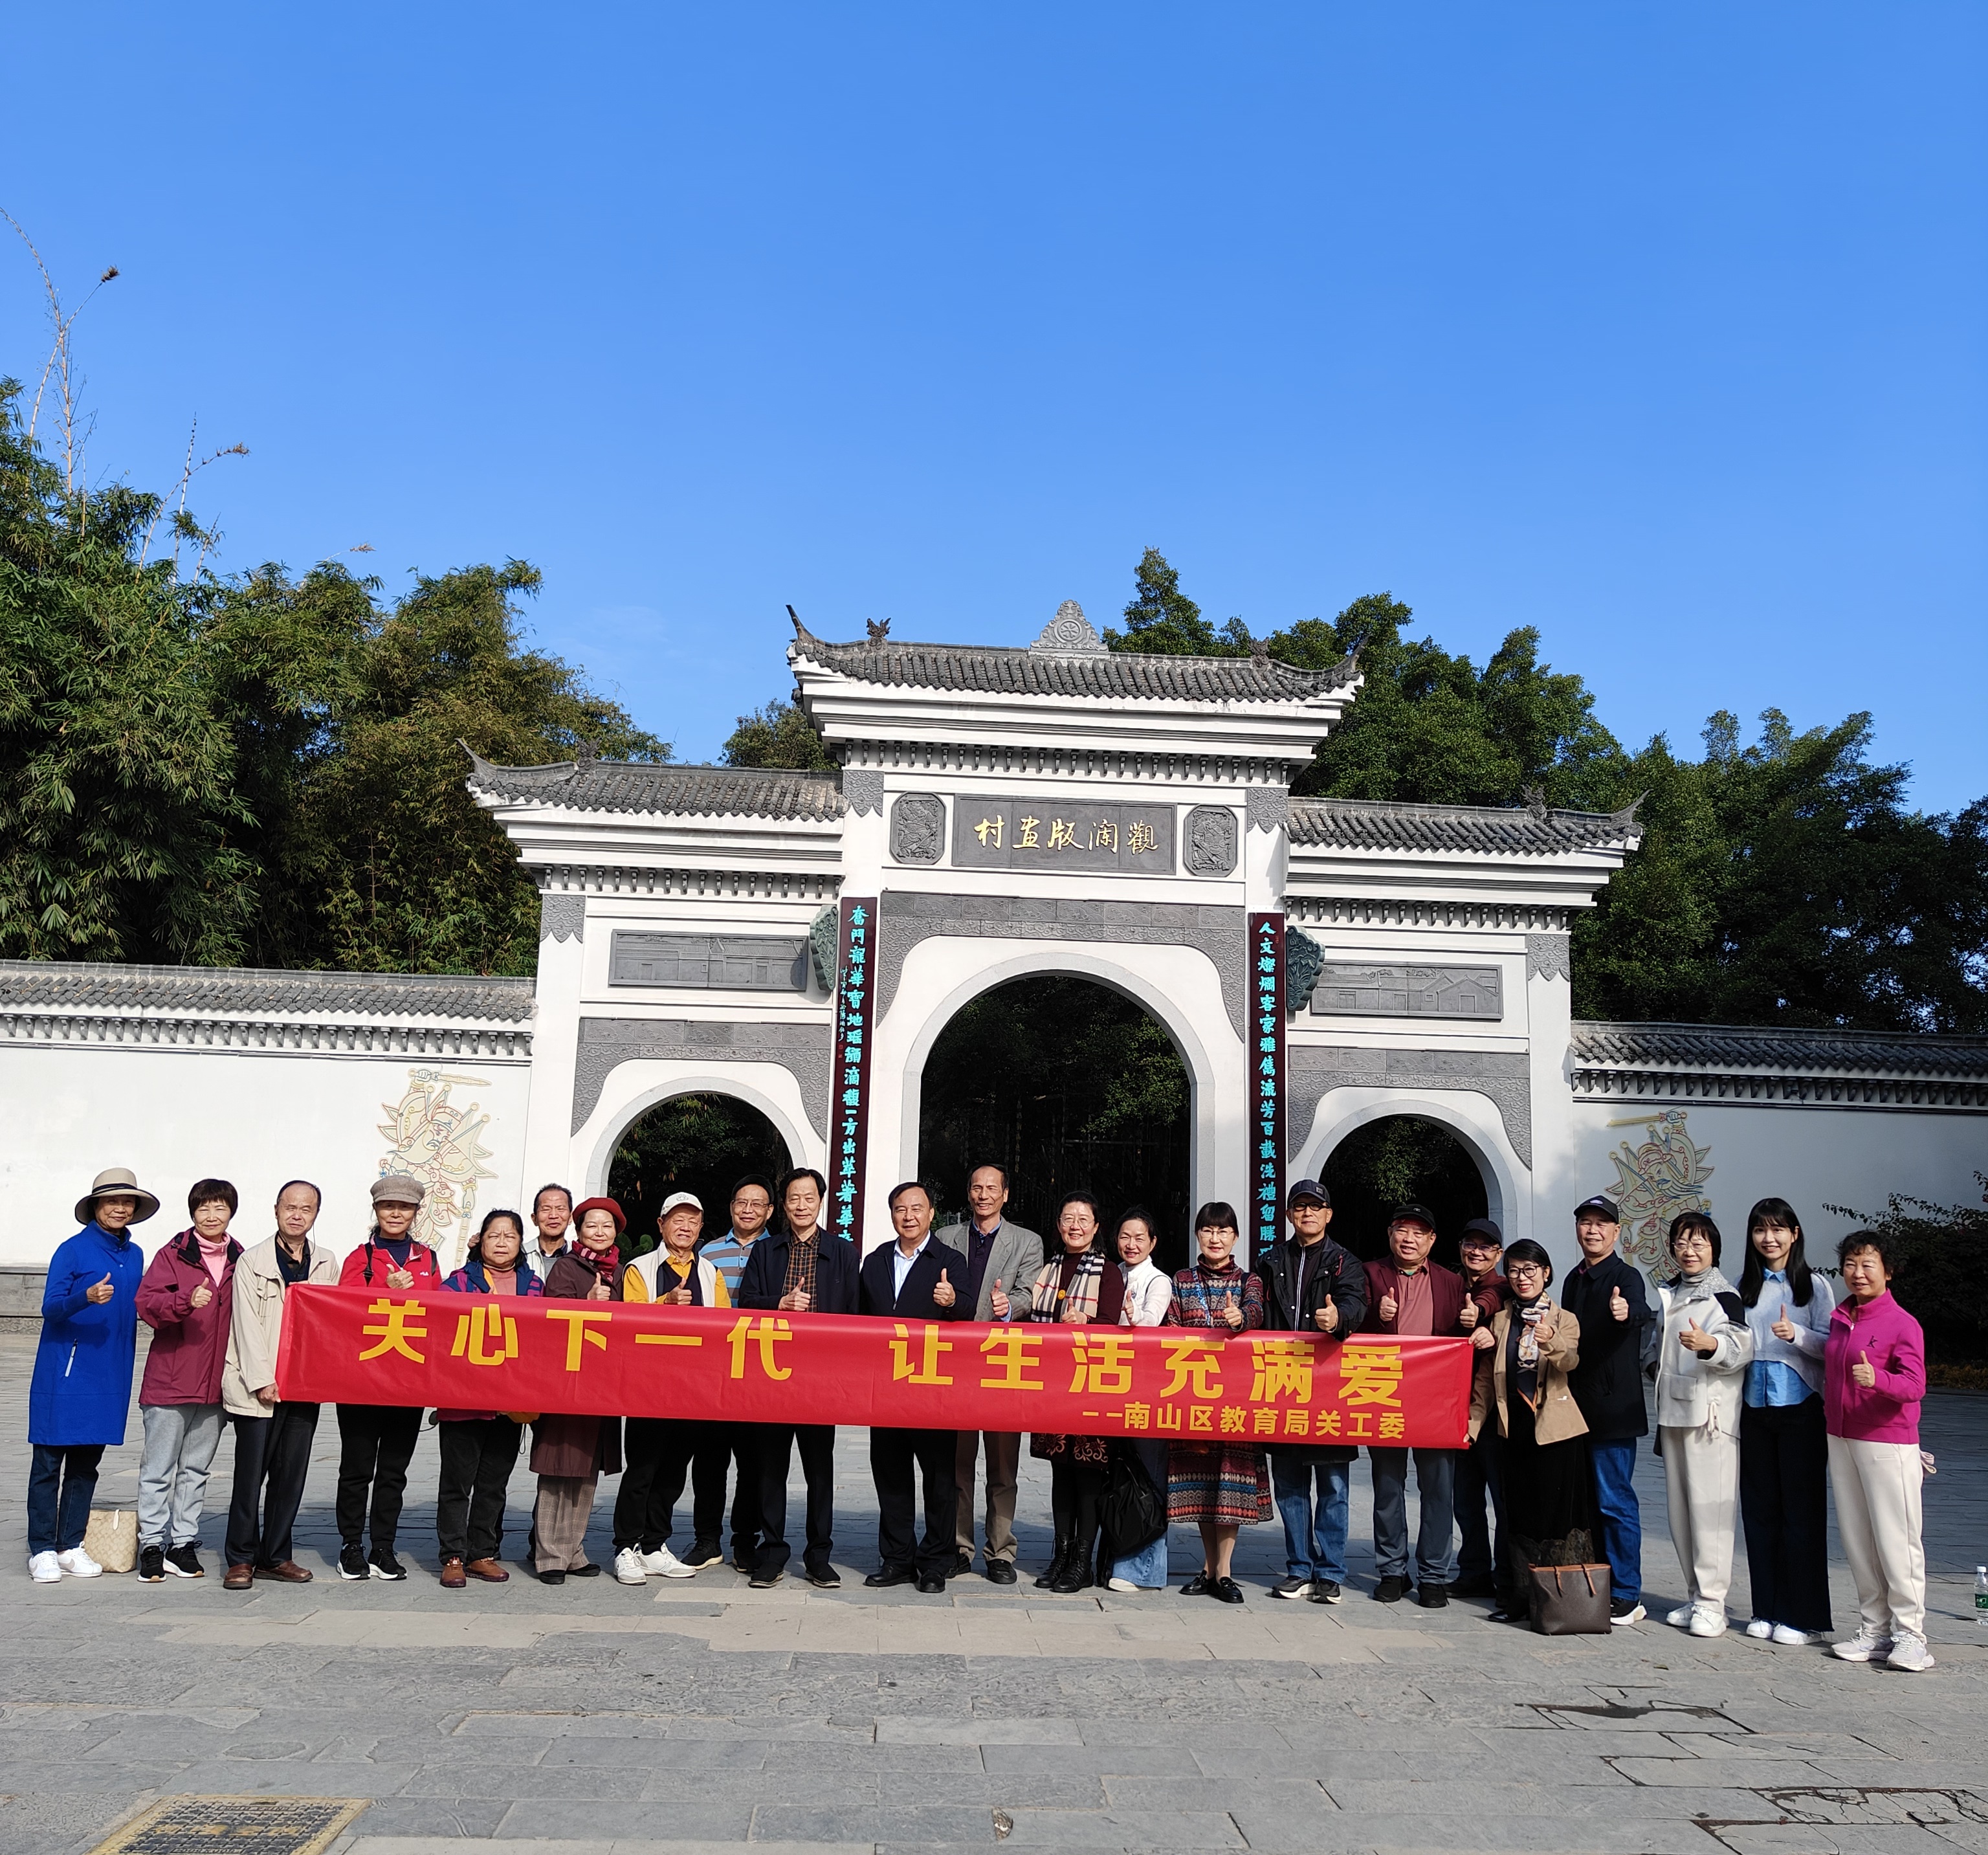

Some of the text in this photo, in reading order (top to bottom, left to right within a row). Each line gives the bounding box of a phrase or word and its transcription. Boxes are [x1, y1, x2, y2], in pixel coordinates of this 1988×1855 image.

[359, 1298, 1404, 1407] 关心下一代 让生活充满爱
